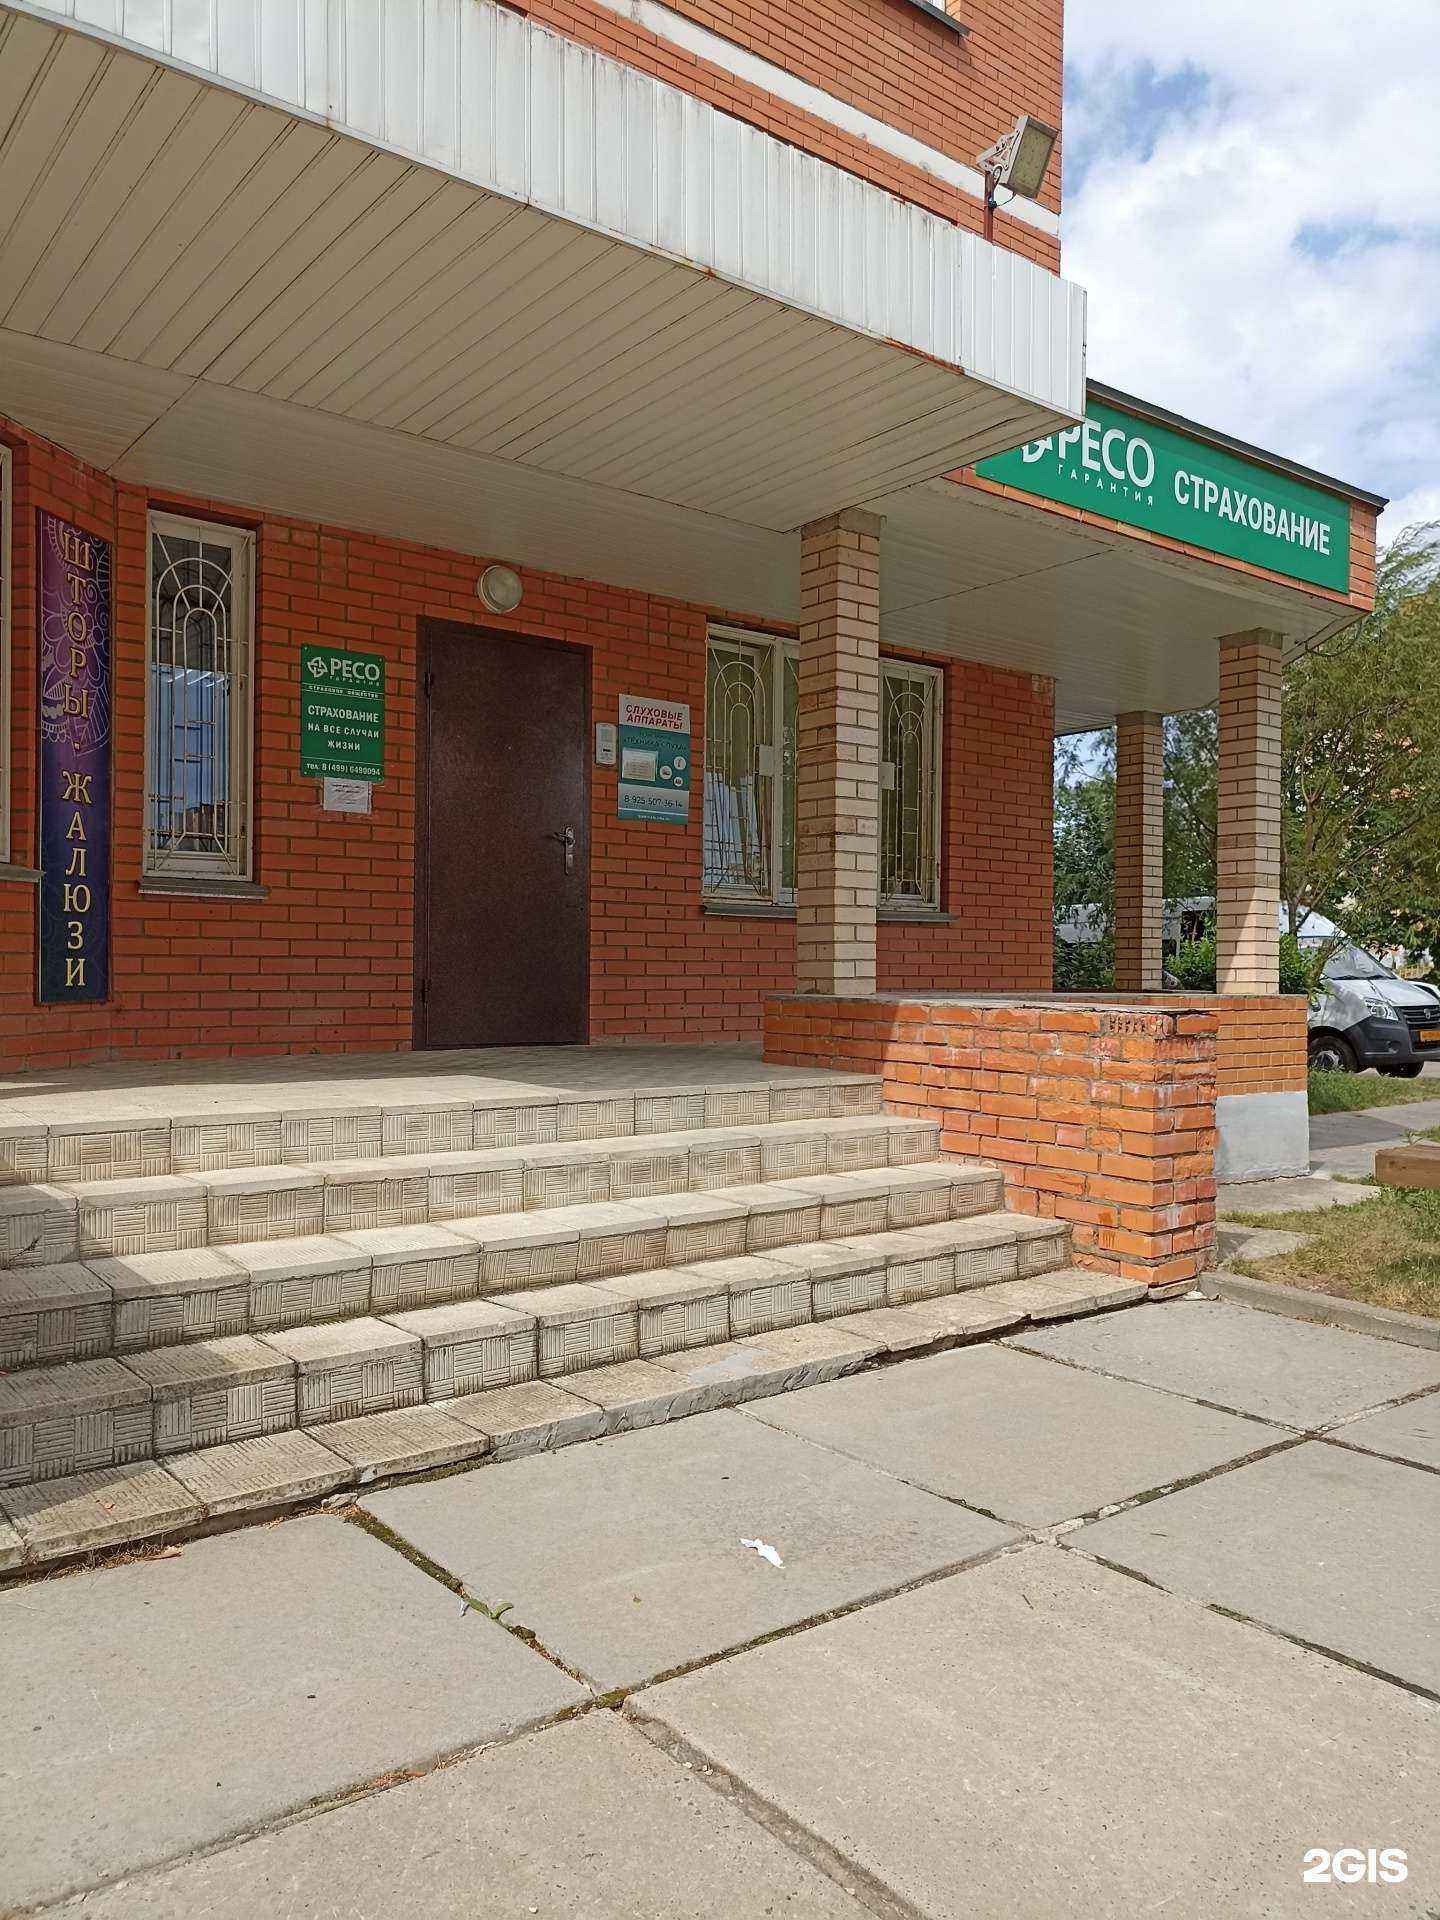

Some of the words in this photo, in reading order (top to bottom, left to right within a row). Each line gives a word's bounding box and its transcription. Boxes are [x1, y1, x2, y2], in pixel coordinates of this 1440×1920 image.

[1058, 421, 1156, 488] РЕСО
[1058, 464, 1154, 507] ГАРАНТИЯ
[1173, 470, 1331, 556] СТРАХОВАНИЕ
[62, 531, 94, 718] ШТОРЫ
[330, 657, 380, 681] РЕСО
[307, 704, 380, 723] СТРАХОВАНИЕ
[625, 704, 683, 721] СЛУХОВЫЕ
[626, 713, 683, 730] АППАРАТЫ
[308, 722, 320, 732] НА
[323, 724, 341, 734] ВСЕ
[327, 740, 361, 751] ЖИЗНИ
[321, 763, 327, 771] 8
[61, 769, 93, 988] ЖАЛЮЗИ
